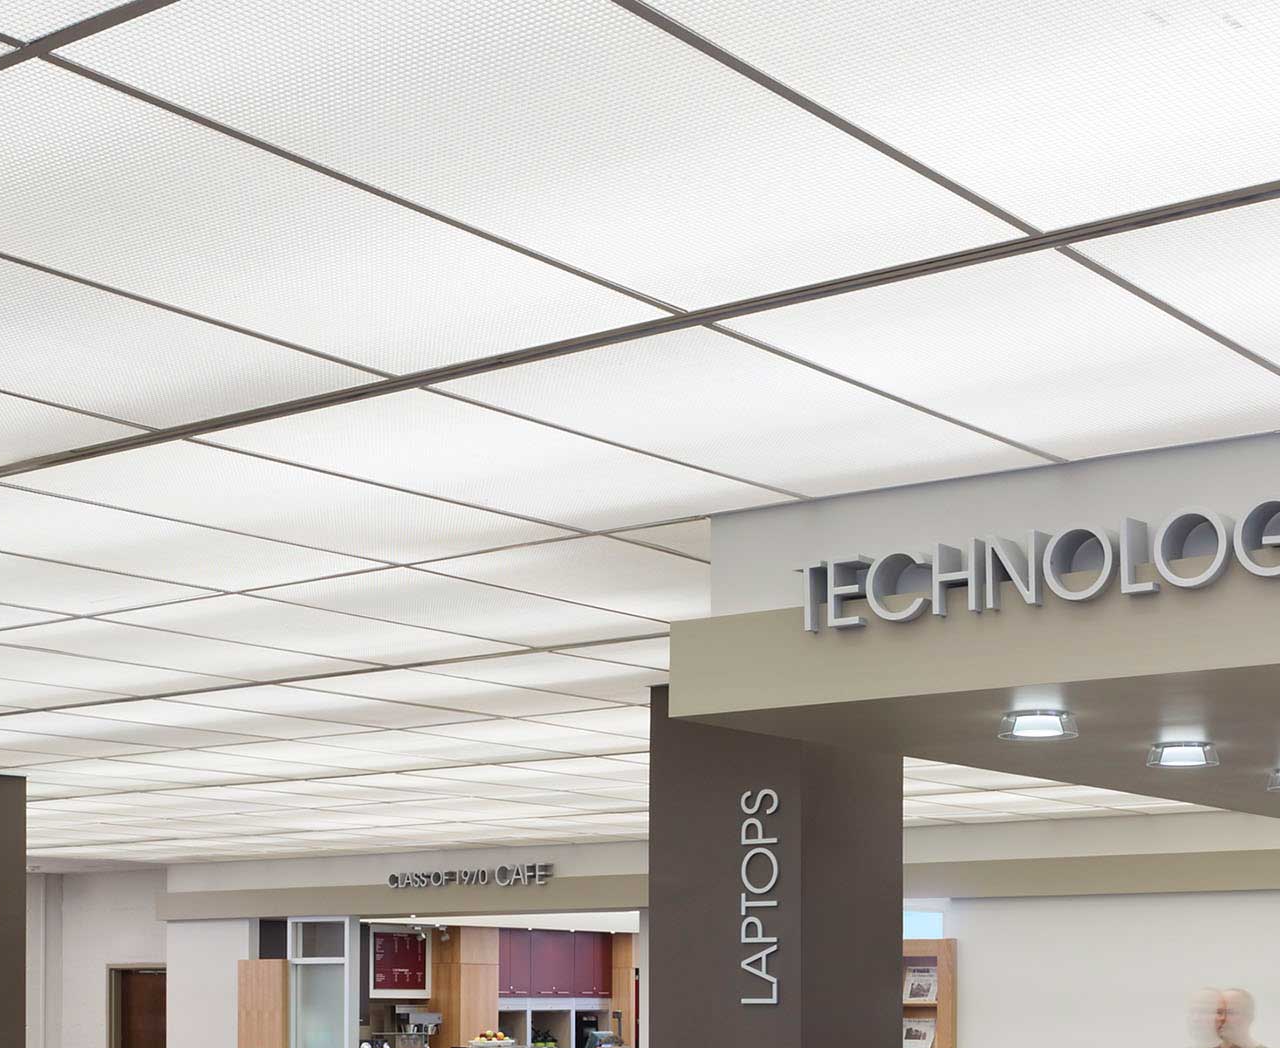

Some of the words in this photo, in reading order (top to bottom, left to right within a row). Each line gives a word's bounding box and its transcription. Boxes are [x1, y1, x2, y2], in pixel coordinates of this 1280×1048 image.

[387, 872, 428, 889] CLASS
[430, 871, 451, 888] OF
[494, 862, 548, 887] CAFE
[740, 787, 780, 1005] LAPTOPS
